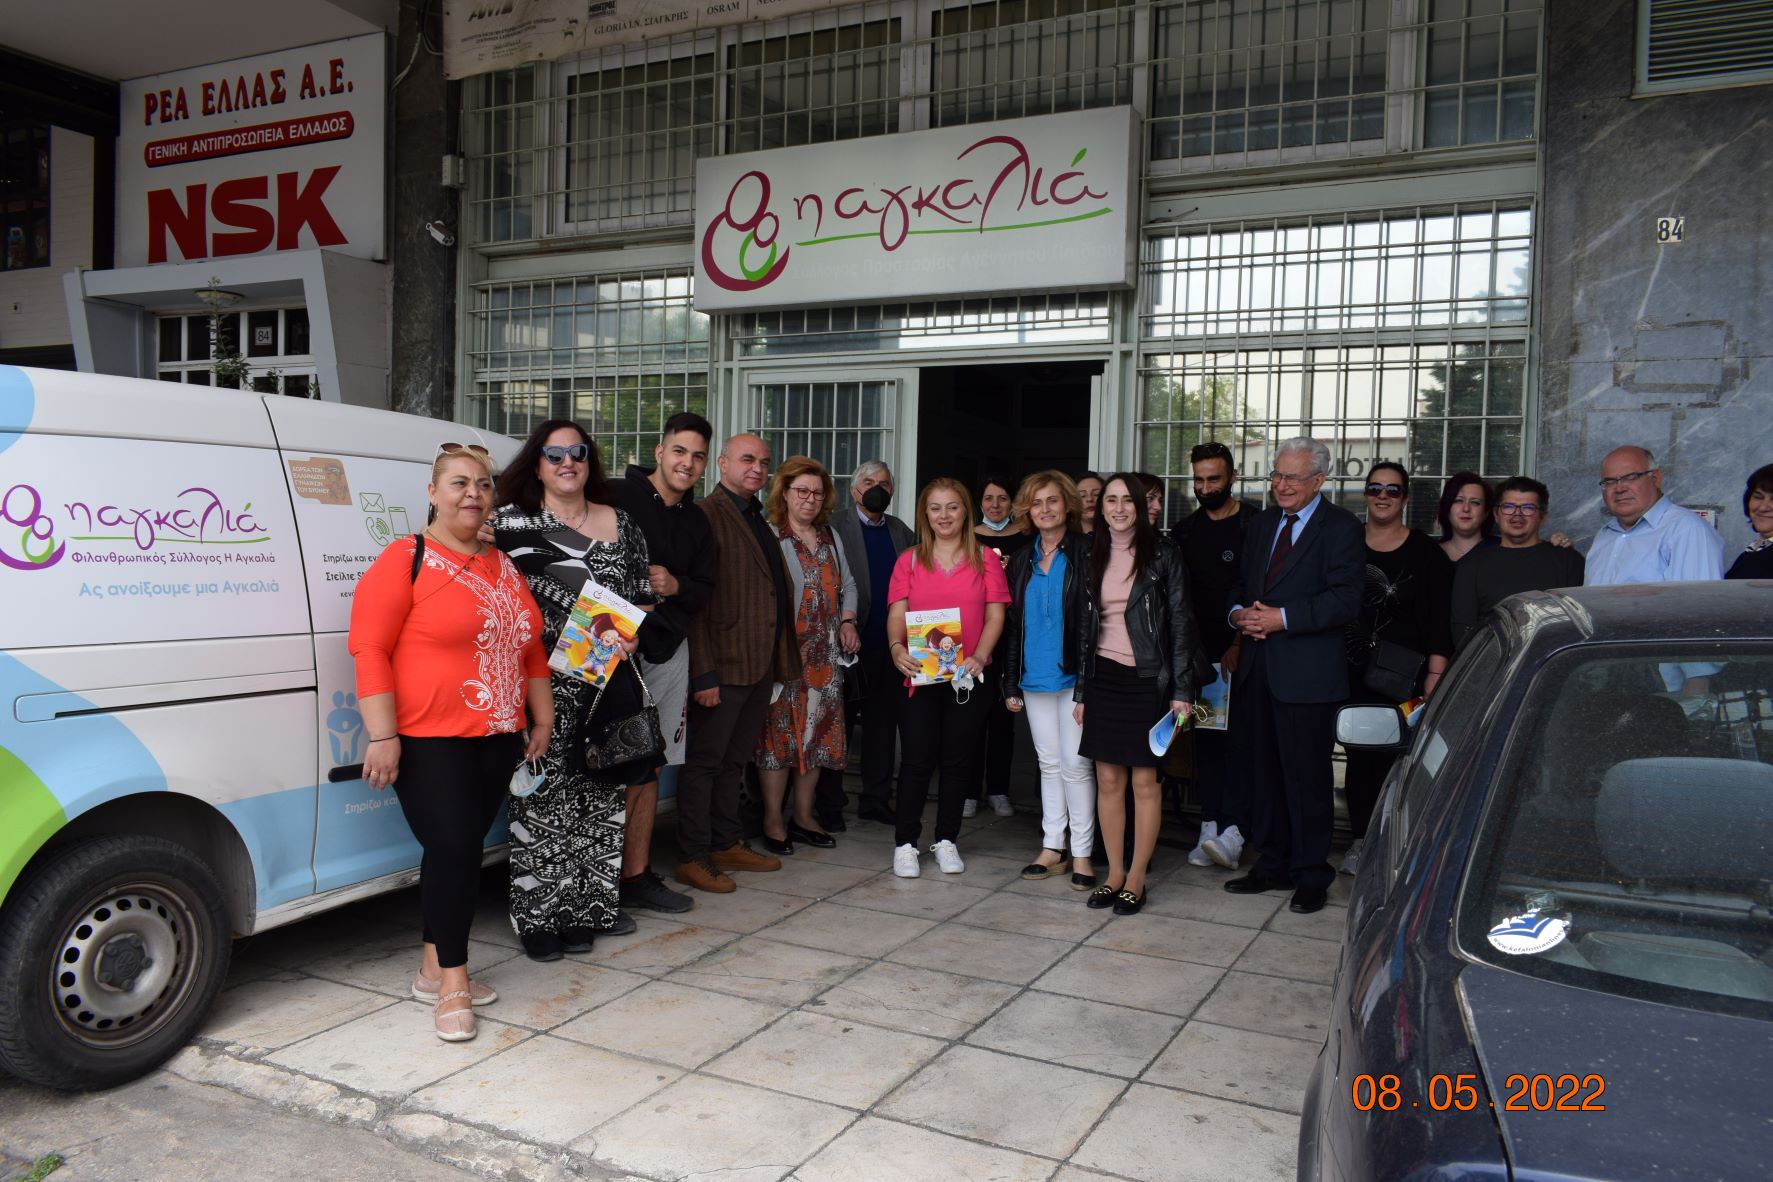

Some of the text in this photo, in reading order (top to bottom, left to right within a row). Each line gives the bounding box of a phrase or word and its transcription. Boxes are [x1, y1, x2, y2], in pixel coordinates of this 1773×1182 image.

[706, 2, 740, 15] OSRAM
[144, 57, 354, 126] ΡΕΑ ΕΛΛΑΣ Α.Ε.
[148, 116, 348, 161] ΓΕΝΙΚΗ ΑΝΤΙΠΡΟΣΩΠΕΙΑ ΕΛΛΑΔΟΣ
[833, 134, 1109, 252] αγκαλιά
[147, 165, 349, 265] NSK
[1658, 219, 1683, 241] 84
[258, 330, 270, 342] 84
[97, 487, 267, 550] αγκαλιά
[71, 551, 275, 566] Φιλανθρωπικός Σύλλογος Η Αγκαλιά
[323, 553, 353, 566] Στηρίζω
[355, 553, 367, 563] και
[326, 571, 355, 582] Στείλτε
[79, 579, 279, 598] Ας ανοίξουμε μια Αγκαλιά
